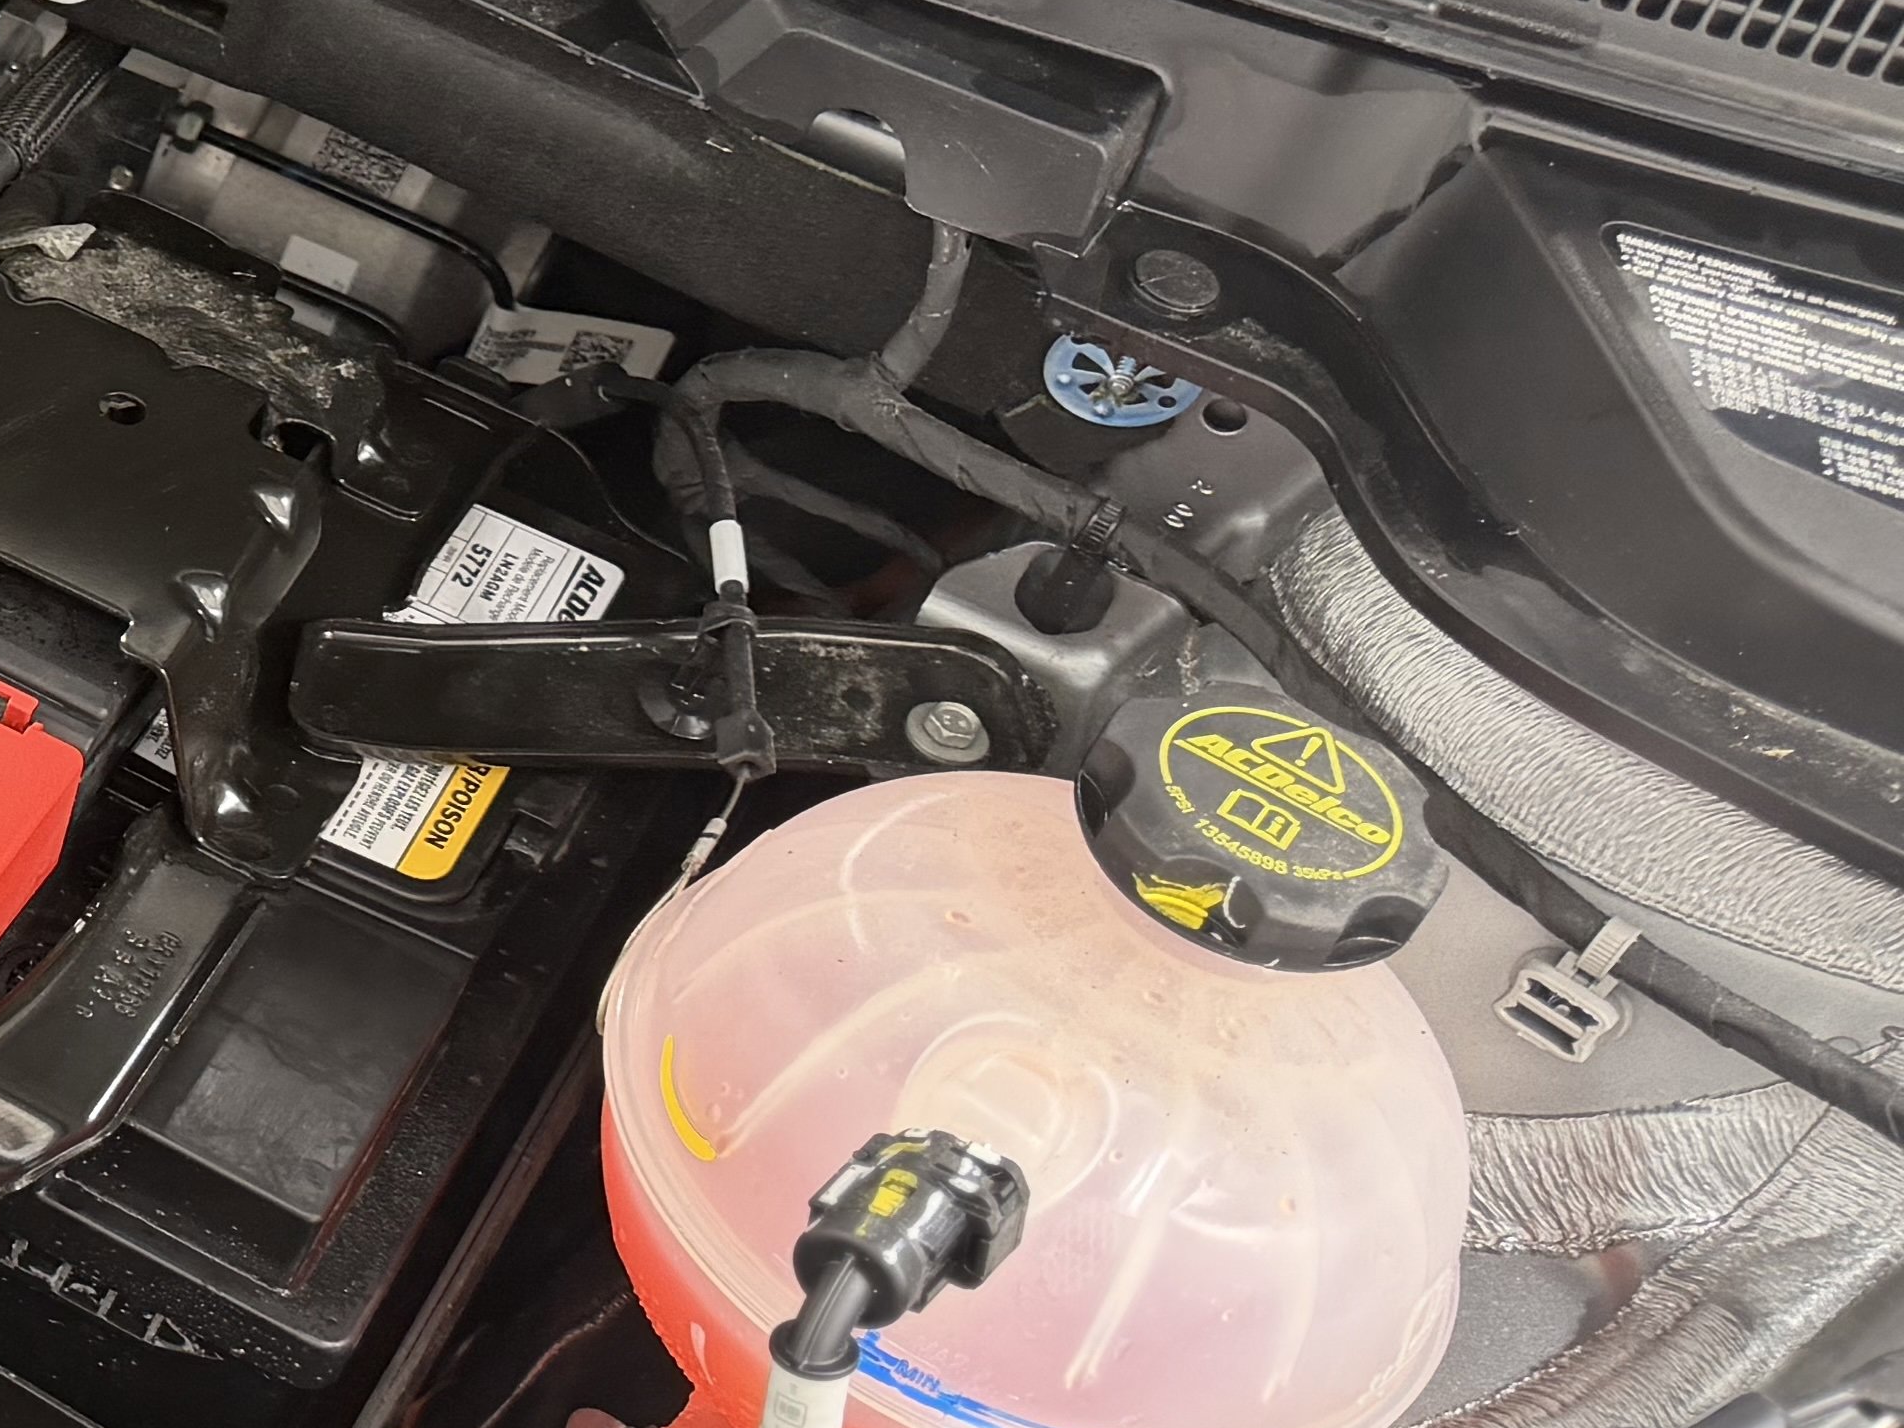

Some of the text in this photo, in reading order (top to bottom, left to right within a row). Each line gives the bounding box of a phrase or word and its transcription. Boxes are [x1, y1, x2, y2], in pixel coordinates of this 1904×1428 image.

[451, 543, 493, 588] 5772
[479, 552, 519, 602] LN2AGM
[1186, 734, 1391, 845] ACDelco
[1194, 819, 1289, 875] 13545898
